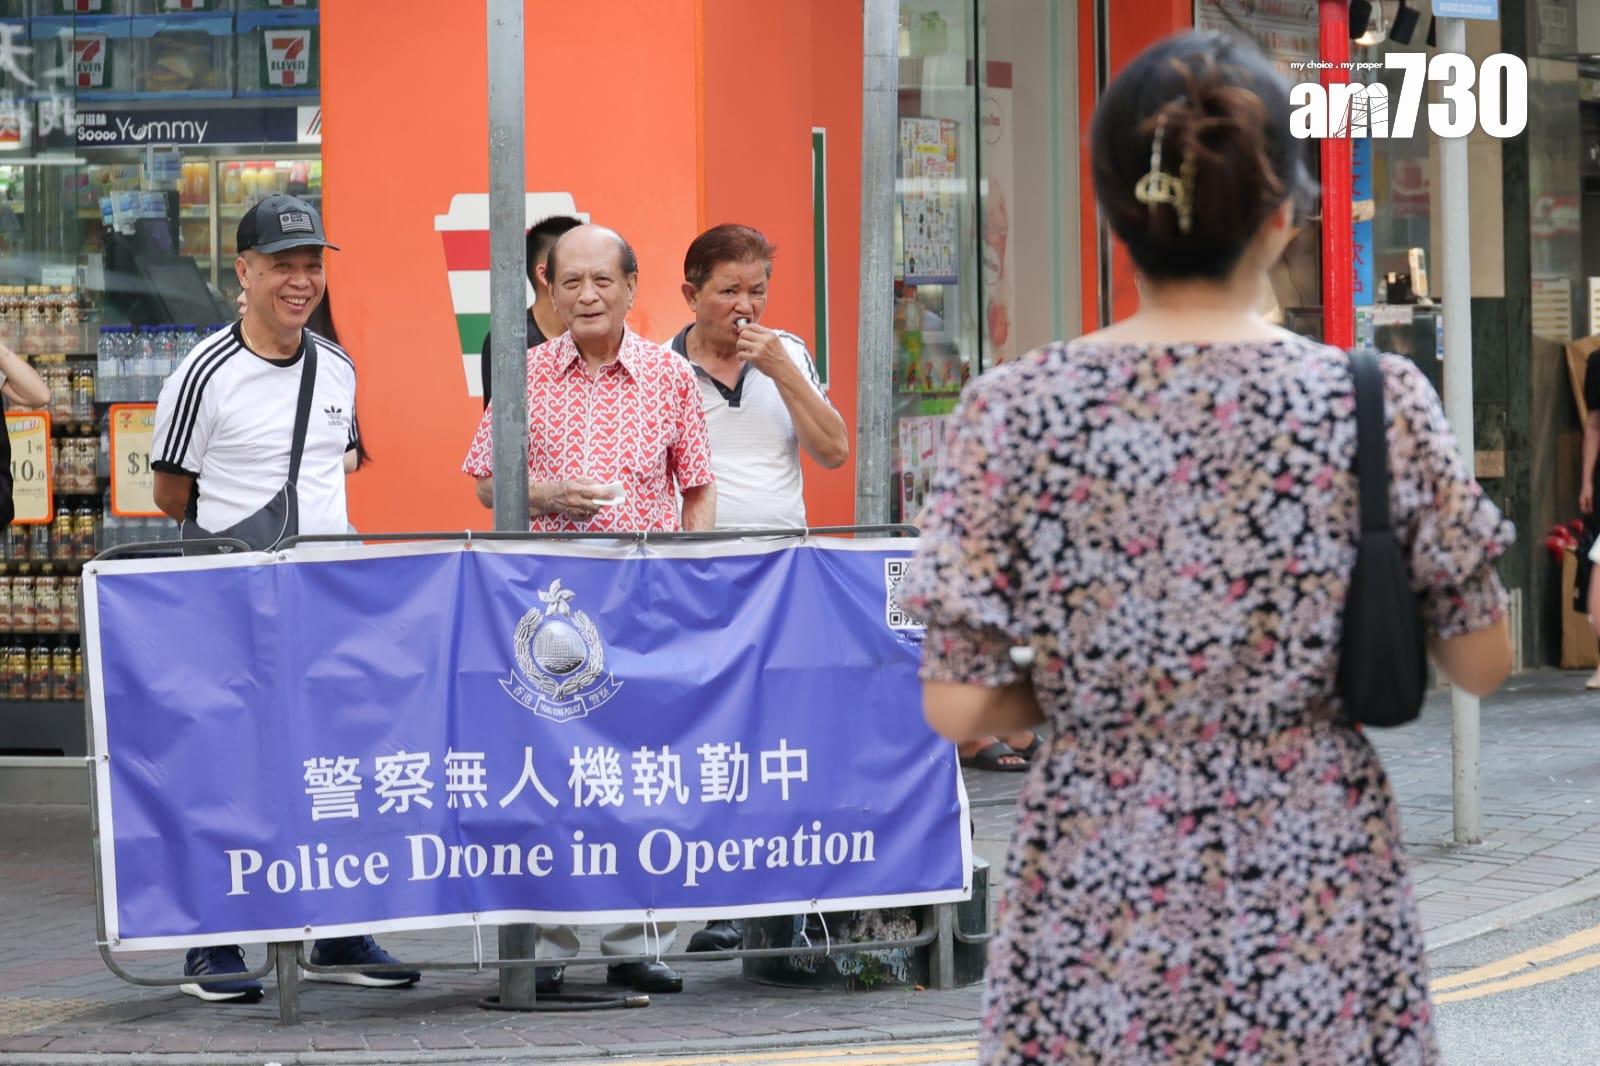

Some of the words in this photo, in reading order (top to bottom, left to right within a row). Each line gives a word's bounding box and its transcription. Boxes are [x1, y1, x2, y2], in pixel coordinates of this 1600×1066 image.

[78, 126, 117, 141] Soooo
[115, 117, 208, 144] Yummy
[303, 738, 808, 822] 警察無人機執勤中
[224, 842, 390, 896] Police
[405, 833, 554, 881] Drone
[570, 829, 619, 877] in
[638, 820, 876, 887] Operation
